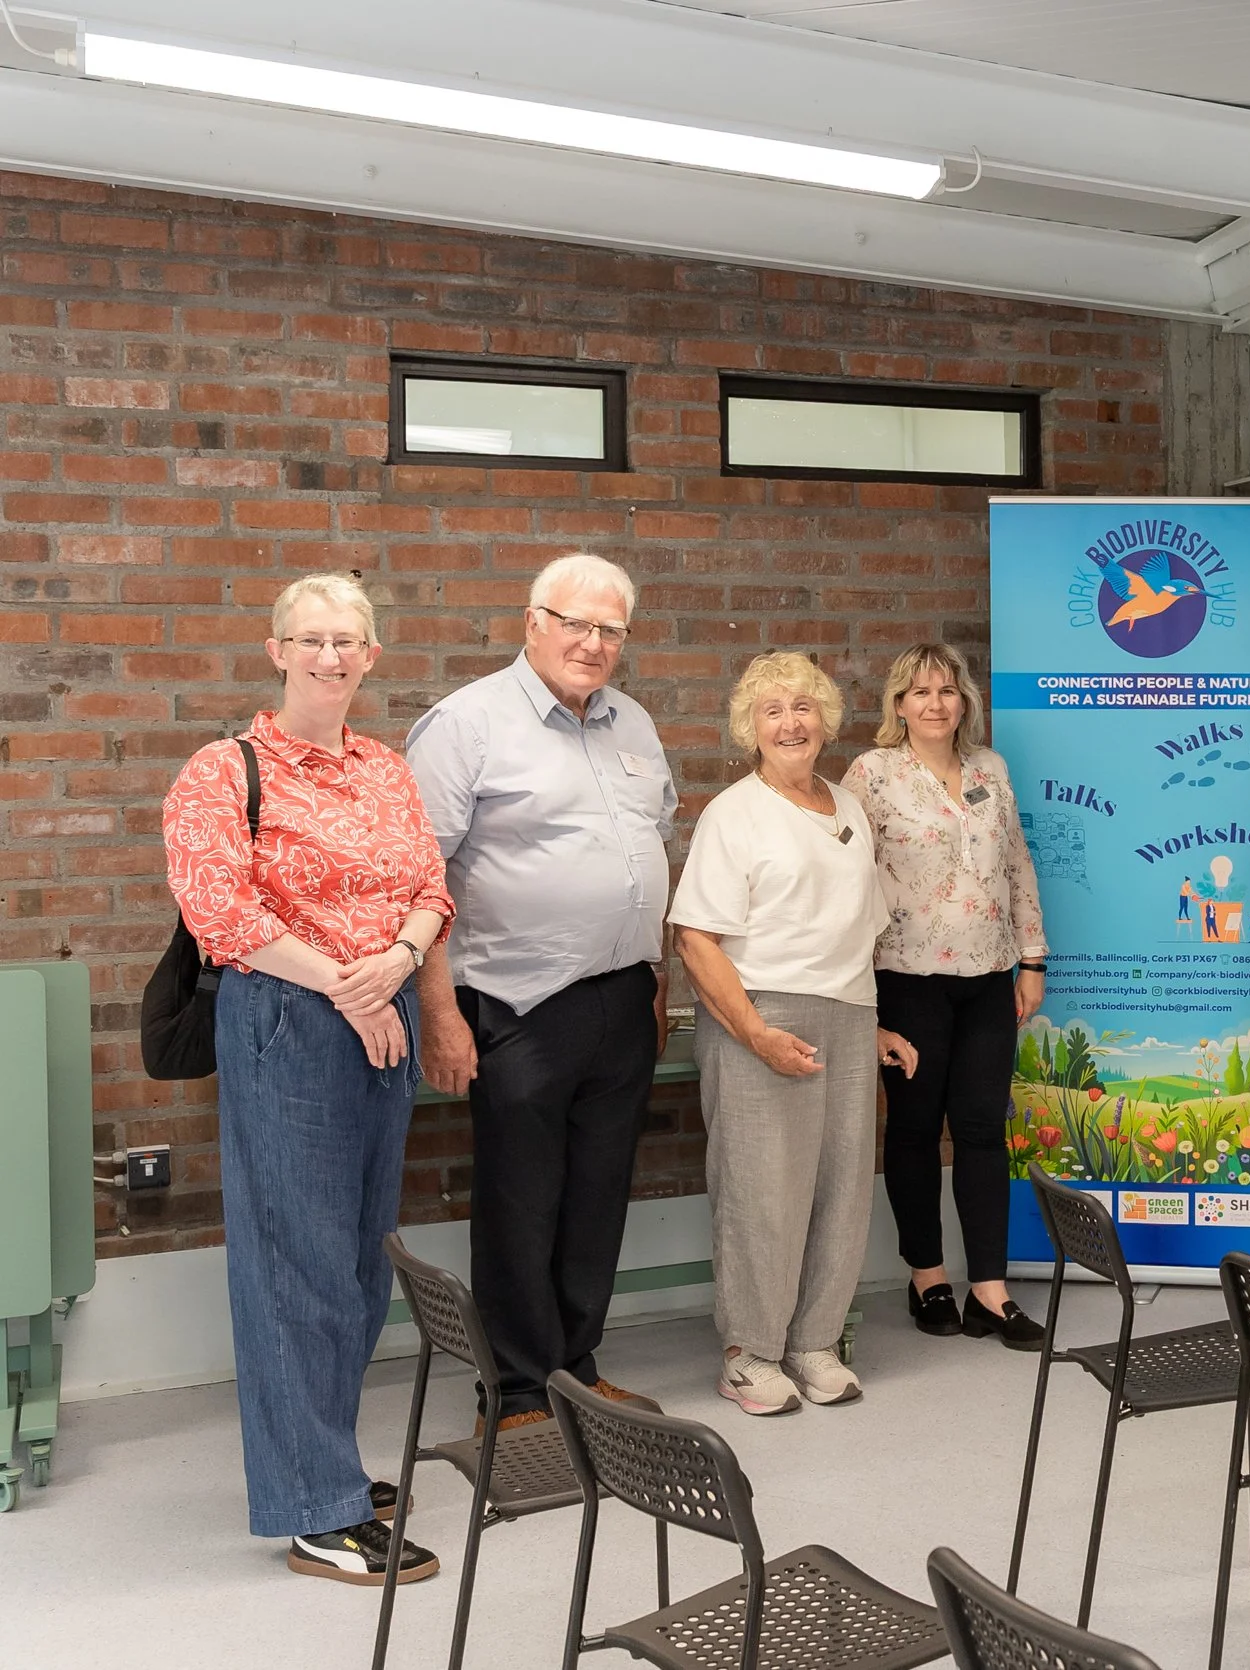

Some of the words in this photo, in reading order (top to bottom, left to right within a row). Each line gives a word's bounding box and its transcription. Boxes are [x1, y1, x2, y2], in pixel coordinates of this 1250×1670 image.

[1068, 566, 1100, 628] CORK
[1085, 519, 1229, 577] BIODIVERSITY
[1209, 582, 1237, 628] HUB
[1038, 677, 1134, 689] CONNECTING
[1137, 677, 1193, 689] PEOPLE
[1197, 677, 1206, 689] &
[1050, 694, 1079, 706] FOR
[1082, 694, 1094, 706] A
[1096, 694, 1196, 706] SUSTAINABLE
[1154, 722, 1243, 760] Walks
[1040, 779, 1117, 817] Talks
[1043, 954, 1093, 962] wdermills,
[1096, 954, 1150, 963] Ballincollig,
[1152, 954, 1173, 963] Cork
[1176, 955, 1190, 963] P31
[1193, 955, 1217, 963] PX67
[1232, 956, 1250, 964] 086
[1045, 986, 1148, 996] @corkbiodiversityhub
[1081, 1002, 1232, 1013] corkbiodiversityhub@gmail.com
